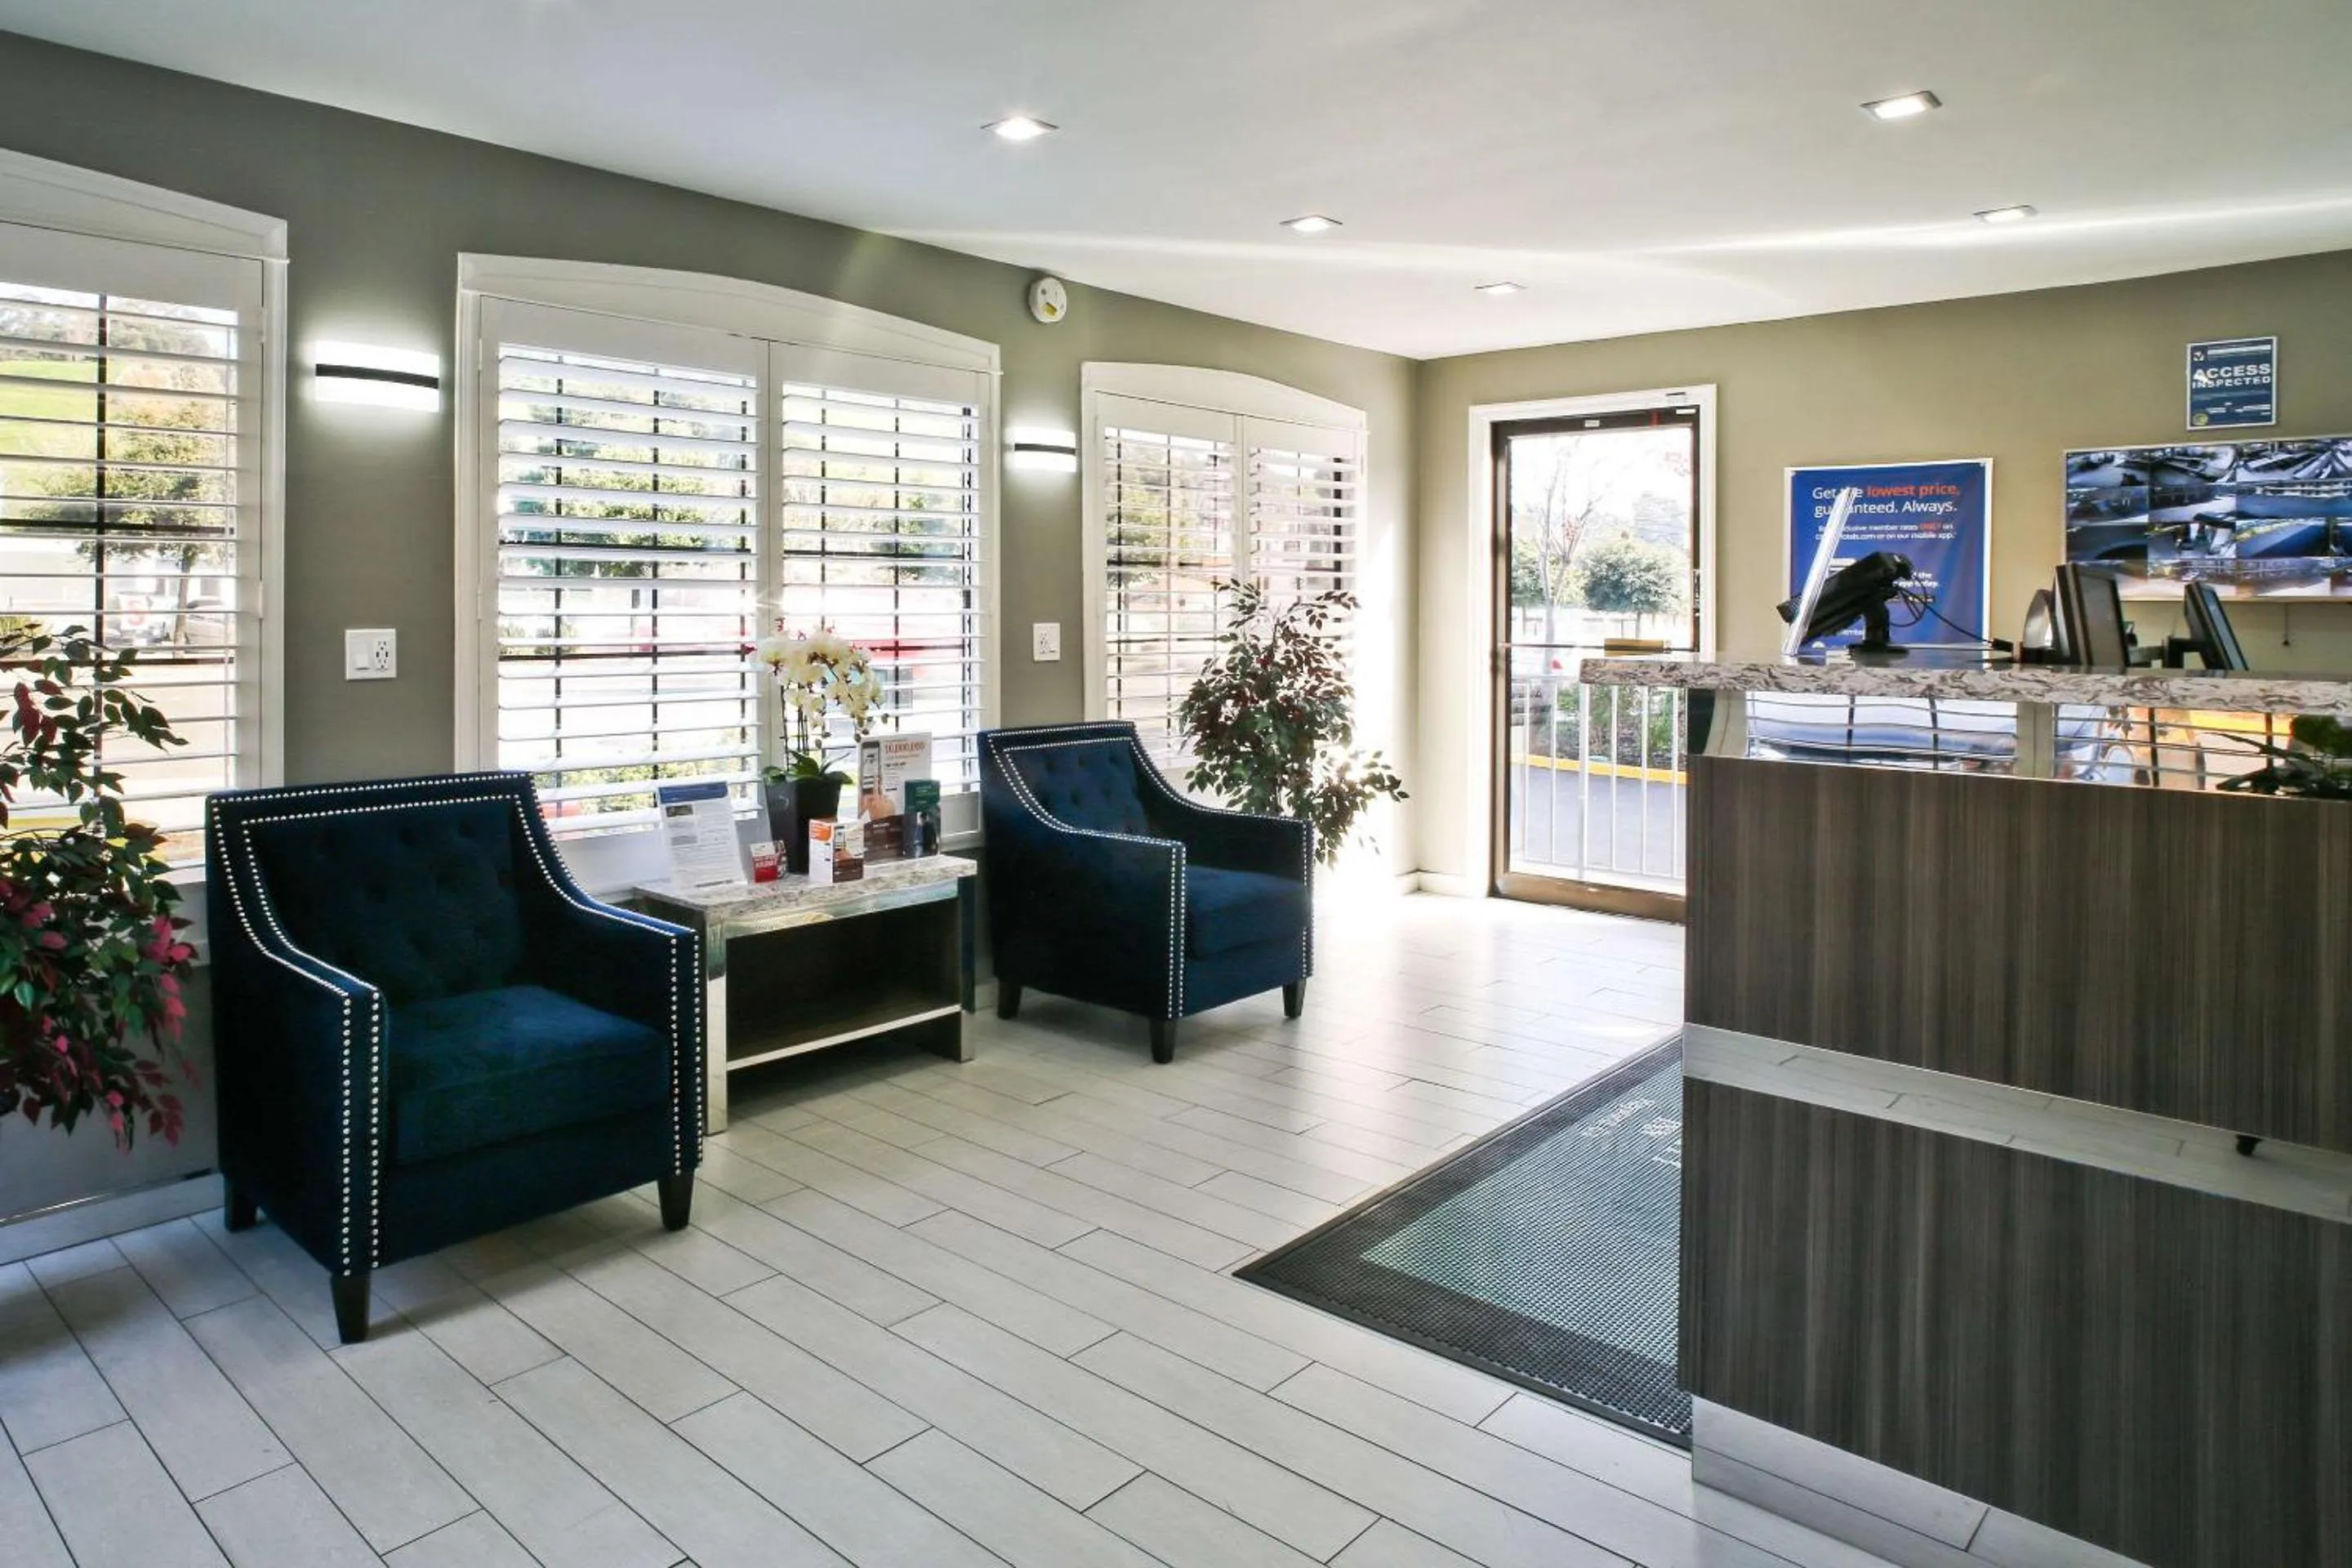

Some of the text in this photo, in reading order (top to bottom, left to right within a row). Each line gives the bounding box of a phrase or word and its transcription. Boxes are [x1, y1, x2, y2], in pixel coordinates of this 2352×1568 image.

[2193, 363, 2271, 381] ACCESS
[2192, 376, 2271, 390] INSPECTED
[1812, 487, 1836, 500] Get
[1867, 485, 1915, 497] lowest
[1902, 500, 1958, 515] Always.
